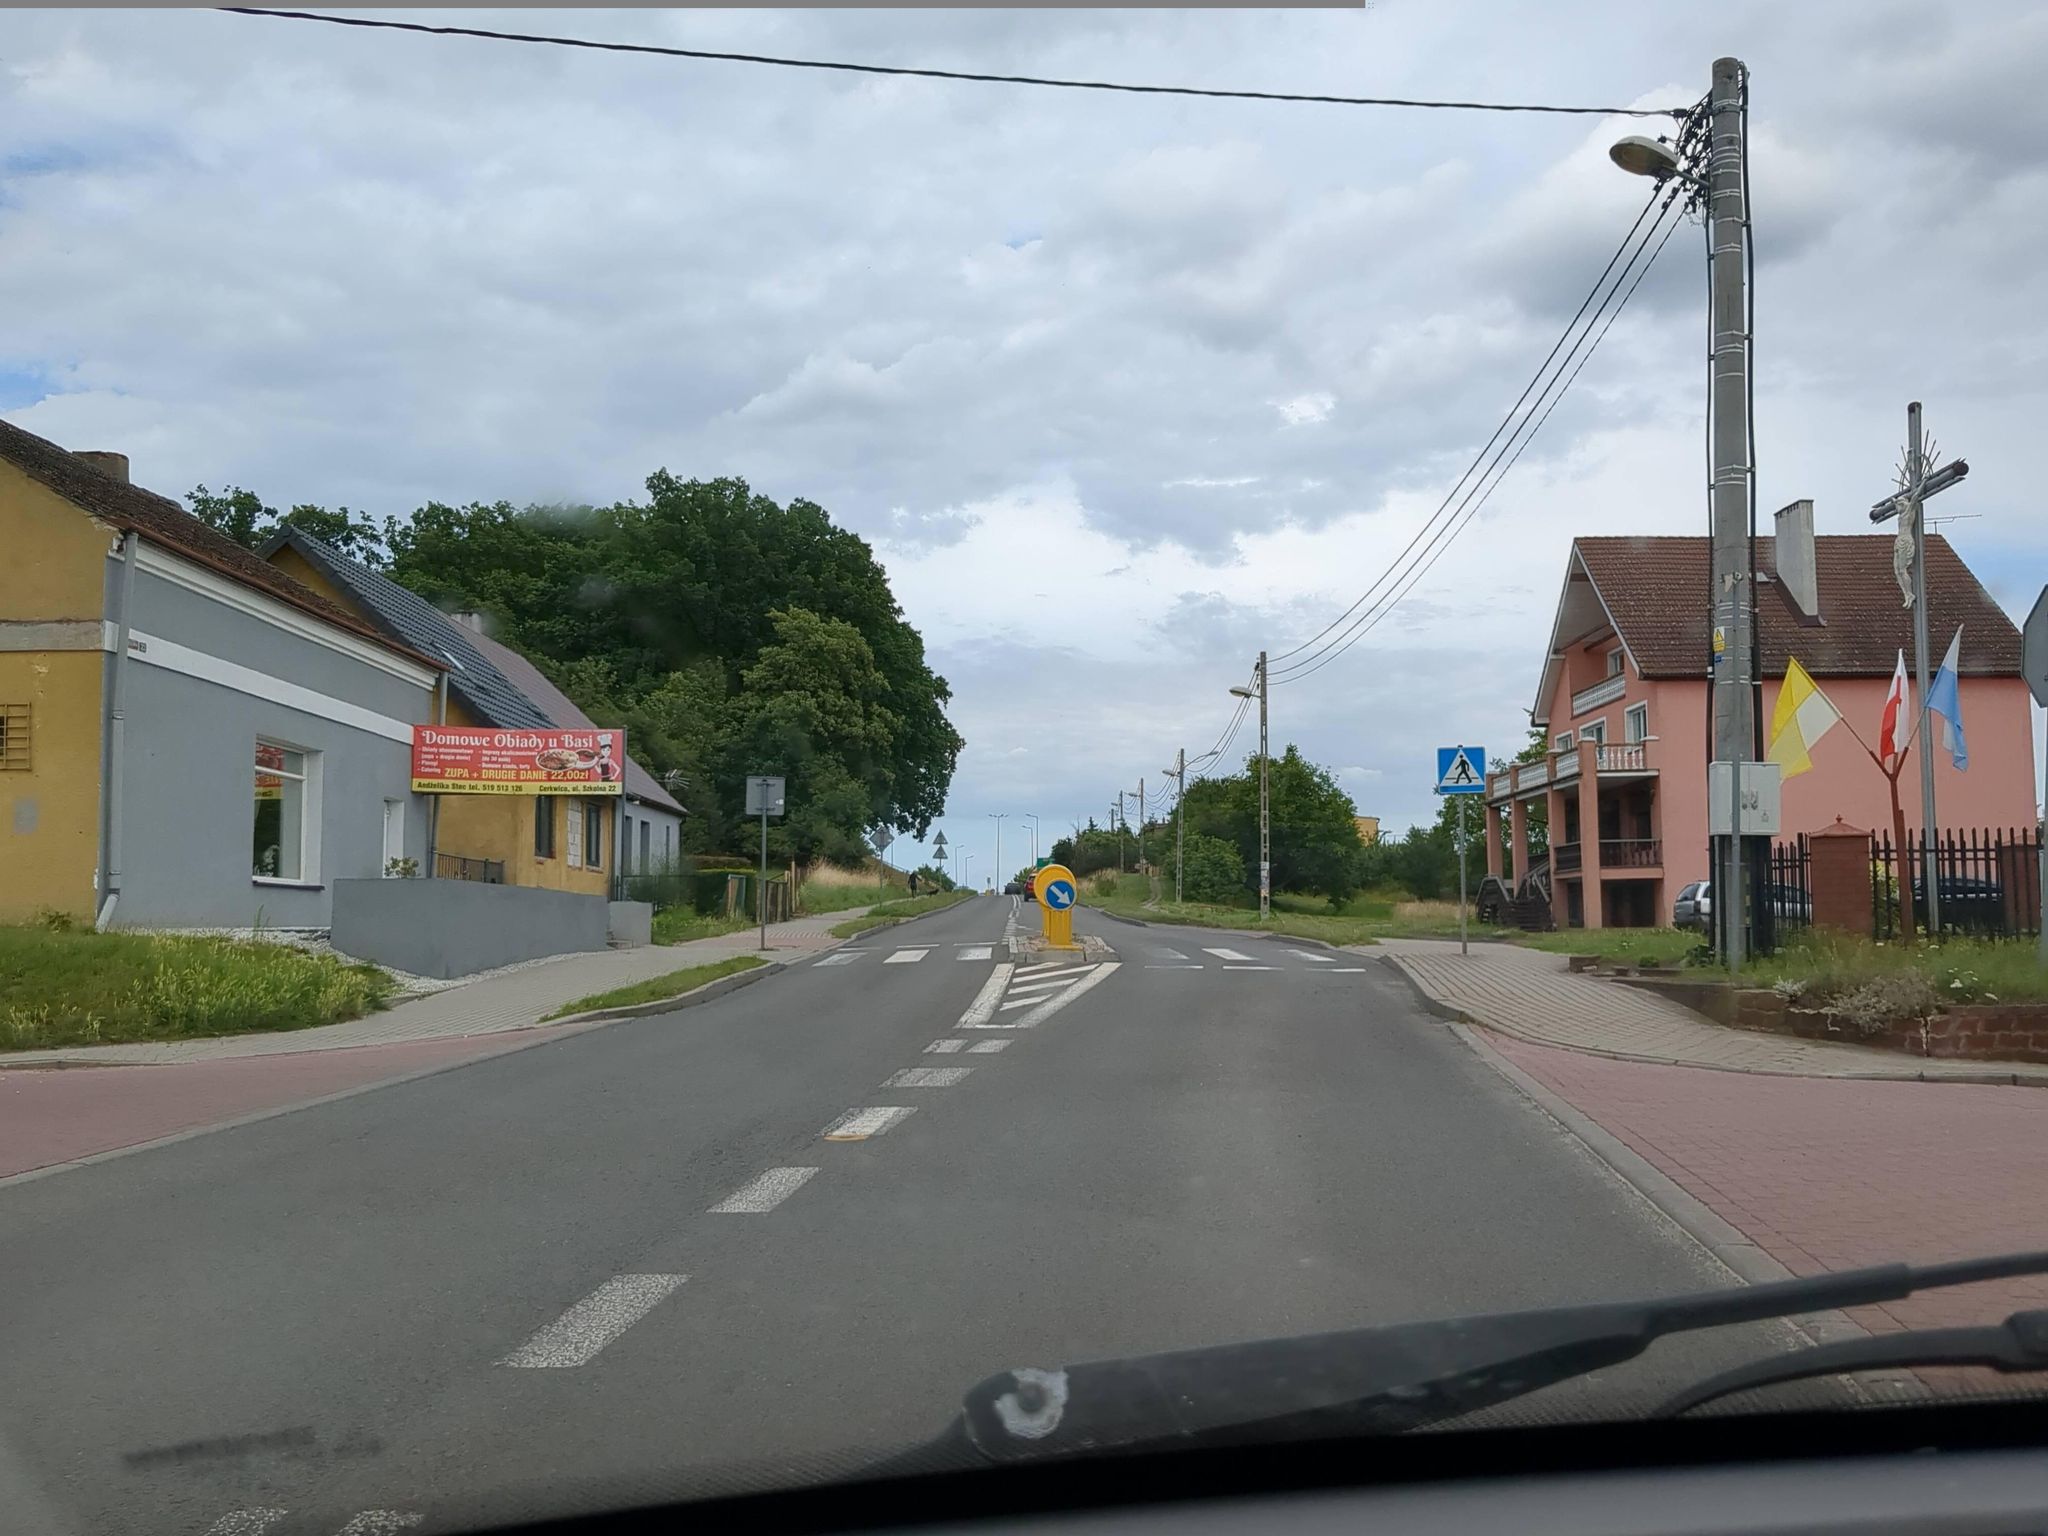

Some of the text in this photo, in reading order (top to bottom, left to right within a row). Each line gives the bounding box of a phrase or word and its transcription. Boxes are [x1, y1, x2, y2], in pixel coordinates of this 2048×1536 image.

[422, 730, 593, 751] Domowe Obiady u Basi
[444, 767, 470, 778] ZUPA
[482, 769, 516, 780] DRUGIE
[520, 770, 547, 780] DANIE
